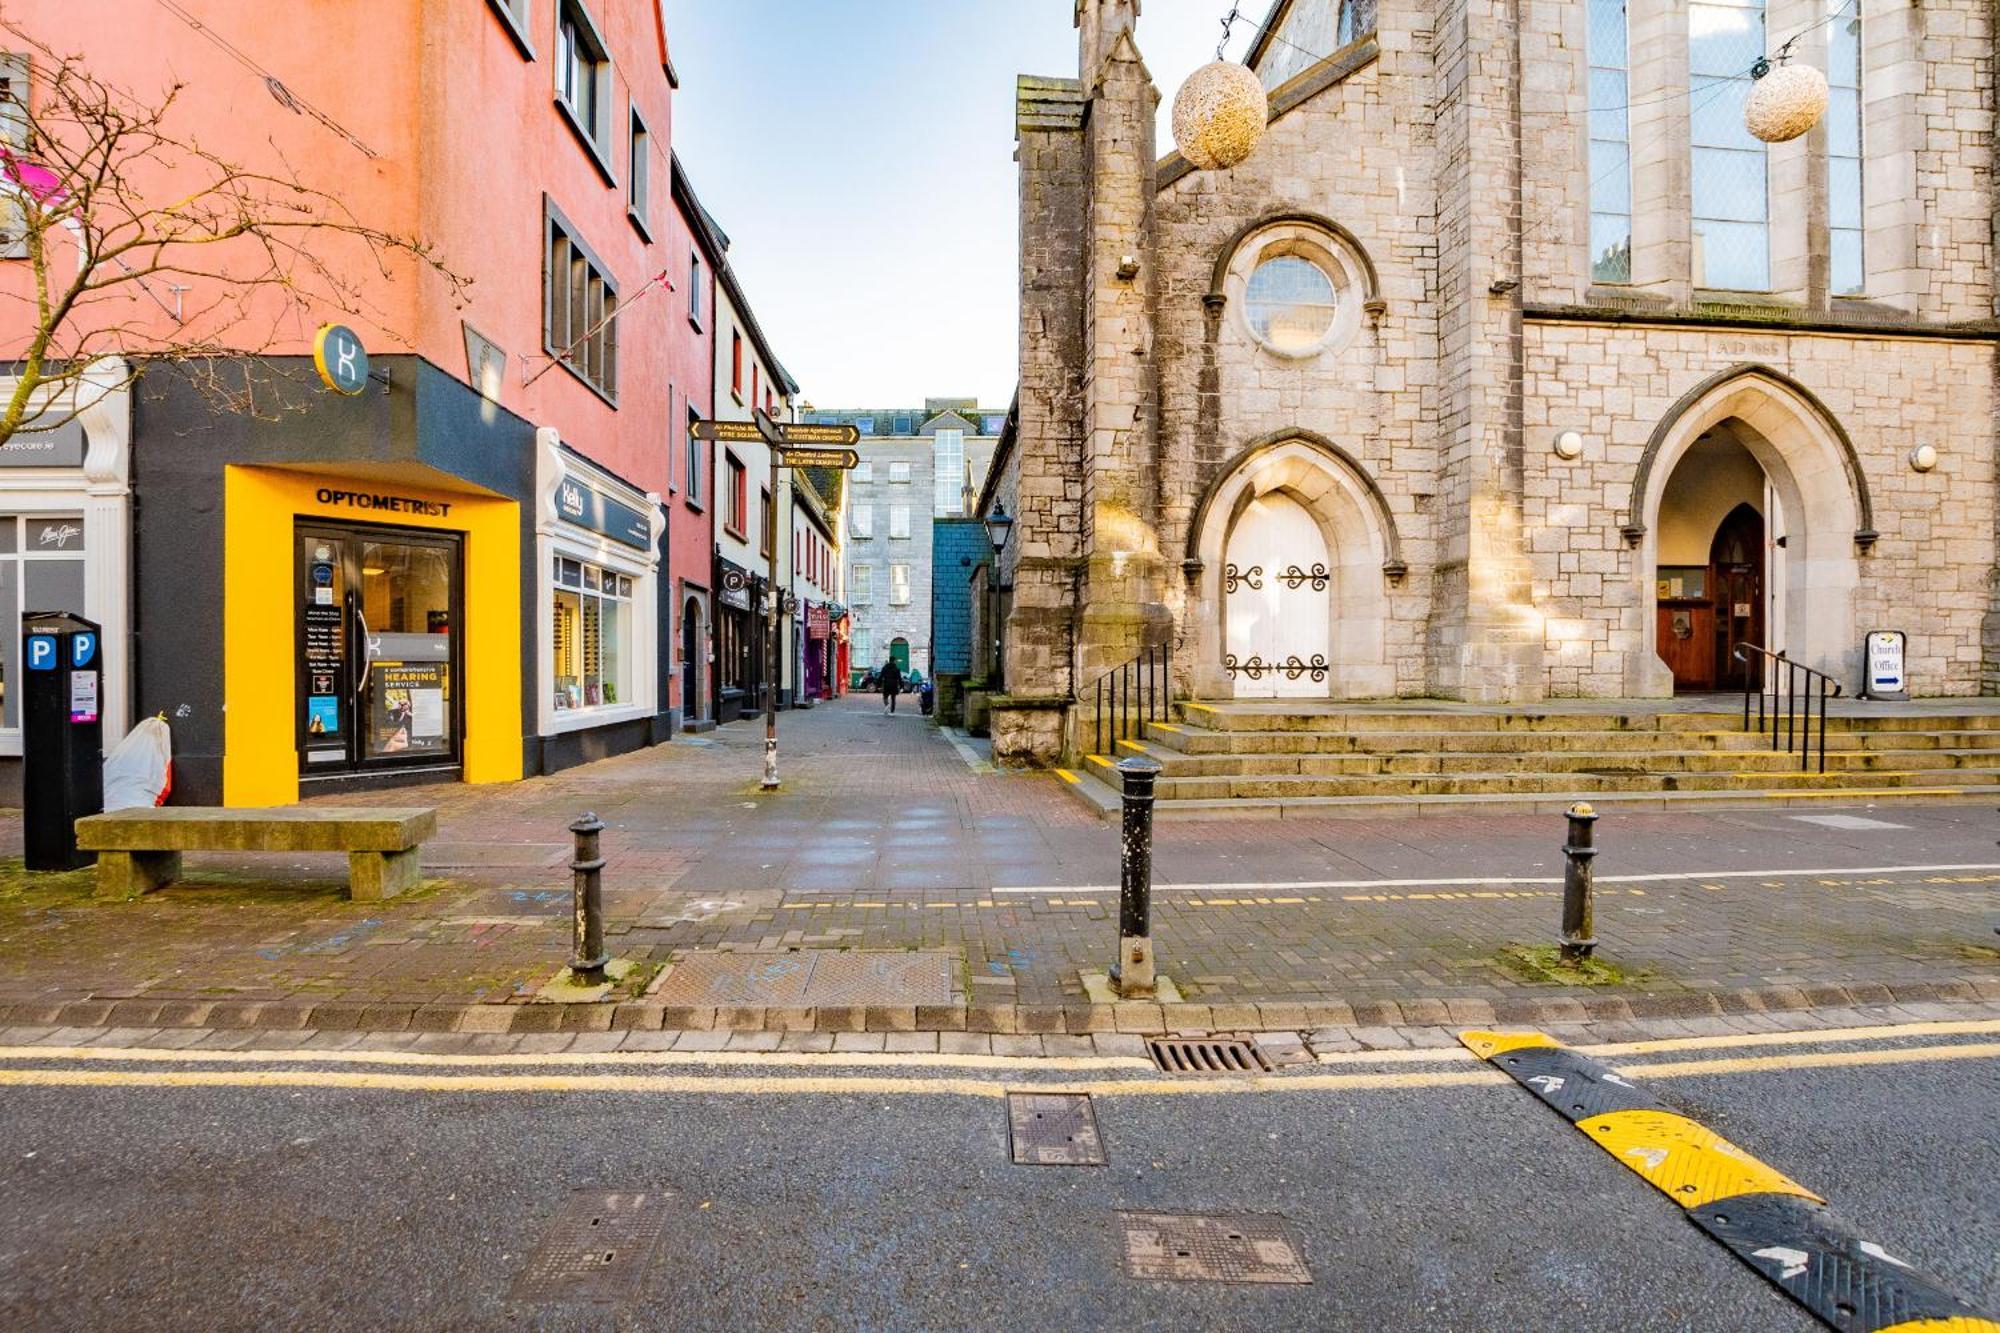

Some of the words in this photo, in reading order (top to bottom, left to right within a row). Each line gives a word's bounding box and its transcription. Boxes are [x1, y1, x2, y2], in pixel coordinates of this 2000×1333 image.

[316, 488, 452, 518] OPTOMETRIST
[563, 482, 584, 516] Kelly
[33, 641, 50, 665] P
[76, 636, 90, 660] P
[1871, 644, 1901, 655] Church
[384, 673, 437, 681] HEARING
[1874, 661, 1899, 671] Office
